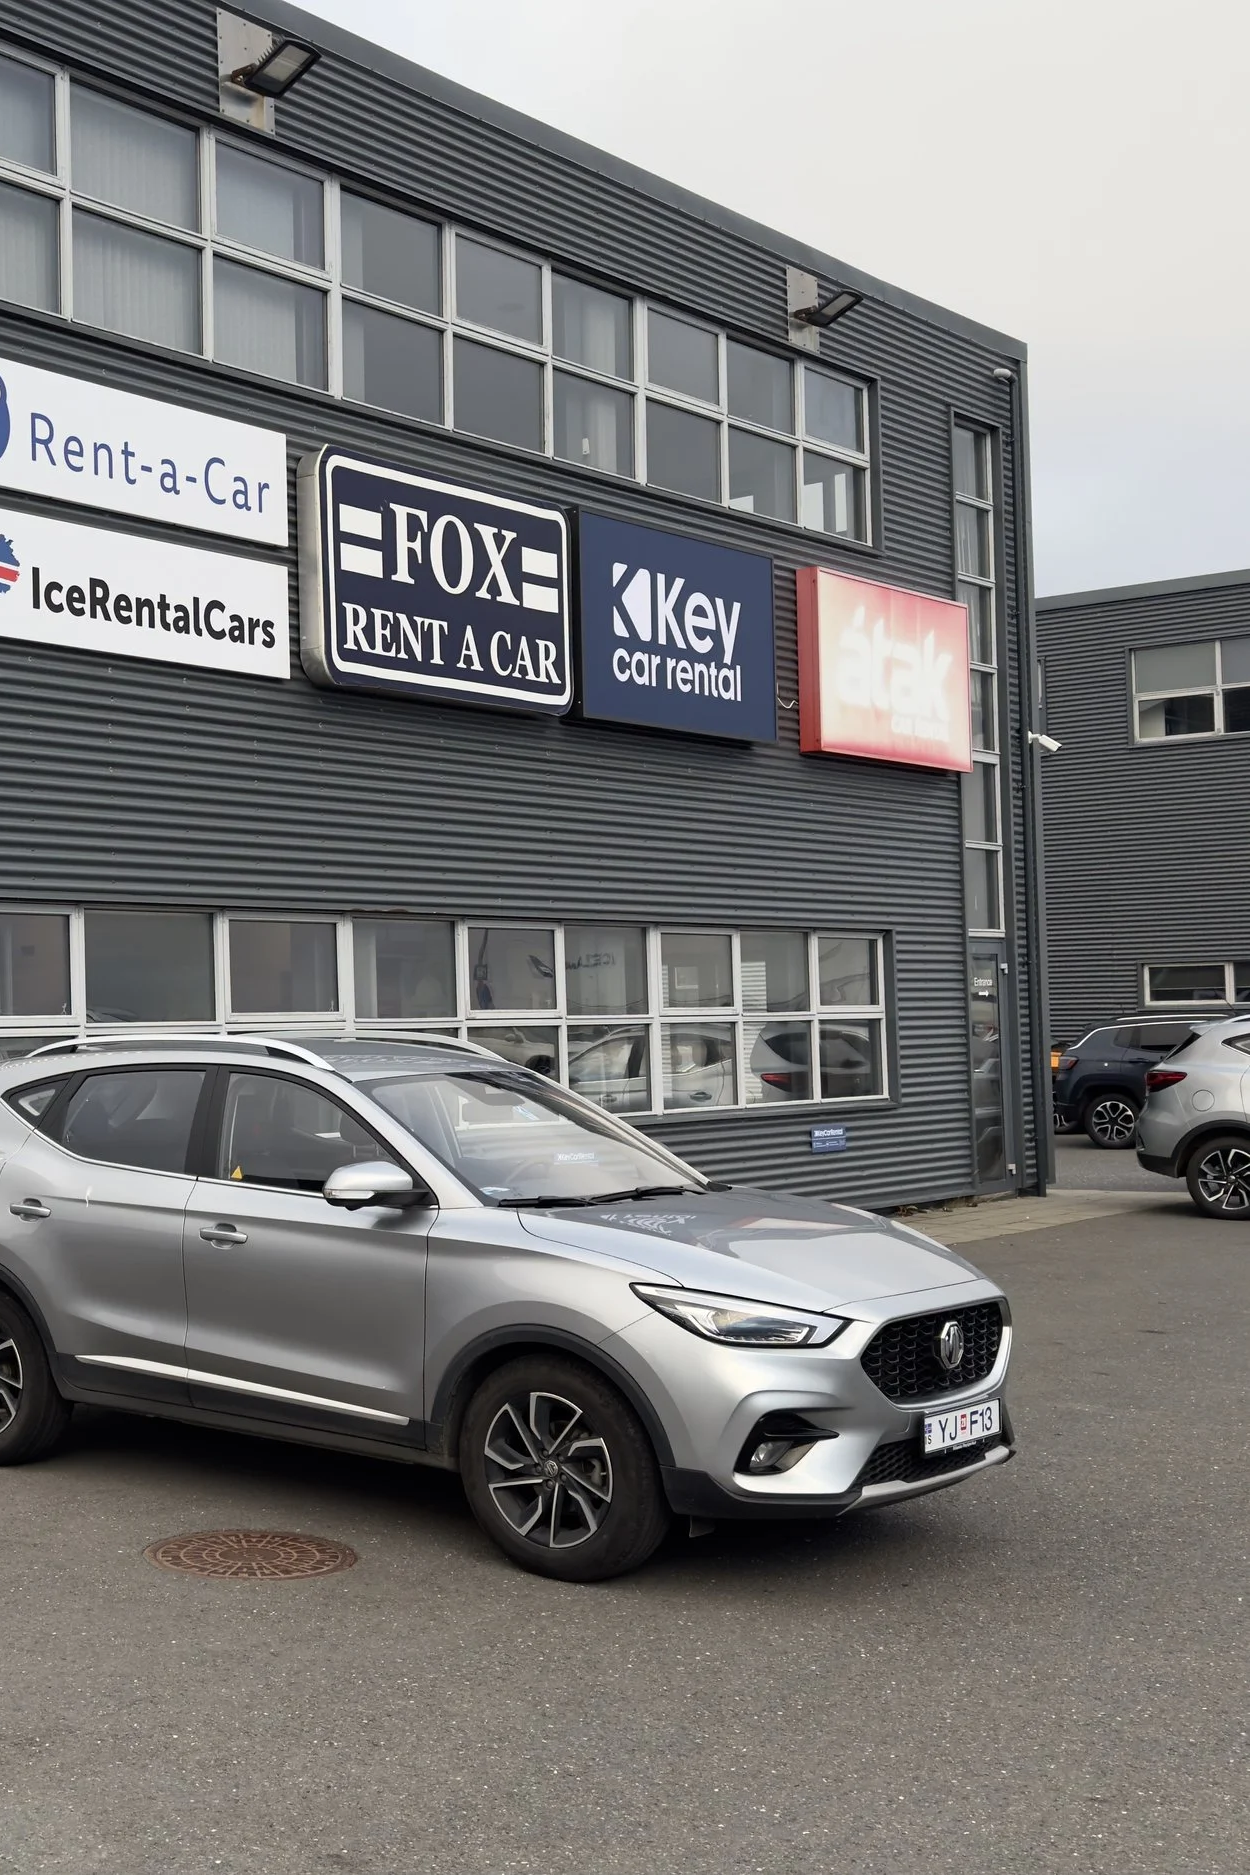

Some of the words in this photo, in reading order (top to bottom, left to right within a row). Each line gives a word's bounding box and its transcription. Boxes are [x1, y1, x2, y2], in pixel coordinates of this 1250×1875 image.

[30, 412, 270, 513] Rent-a-Car
[389, 503, 520, 606] FOX
[31, 567, 276, 649] IceRentalCars
[342, 602, 448, 665] RENT
[457, 625, 484, 672] A
[490, 631, 561, 684] CAR
[656, 572, 741, 665] Key
[612, 648, 660, 687] car
[667, 657, 742, 702] rental
[938, 1416, 958, 1443] YJ
[970, 1407, 993, 1436] F13
